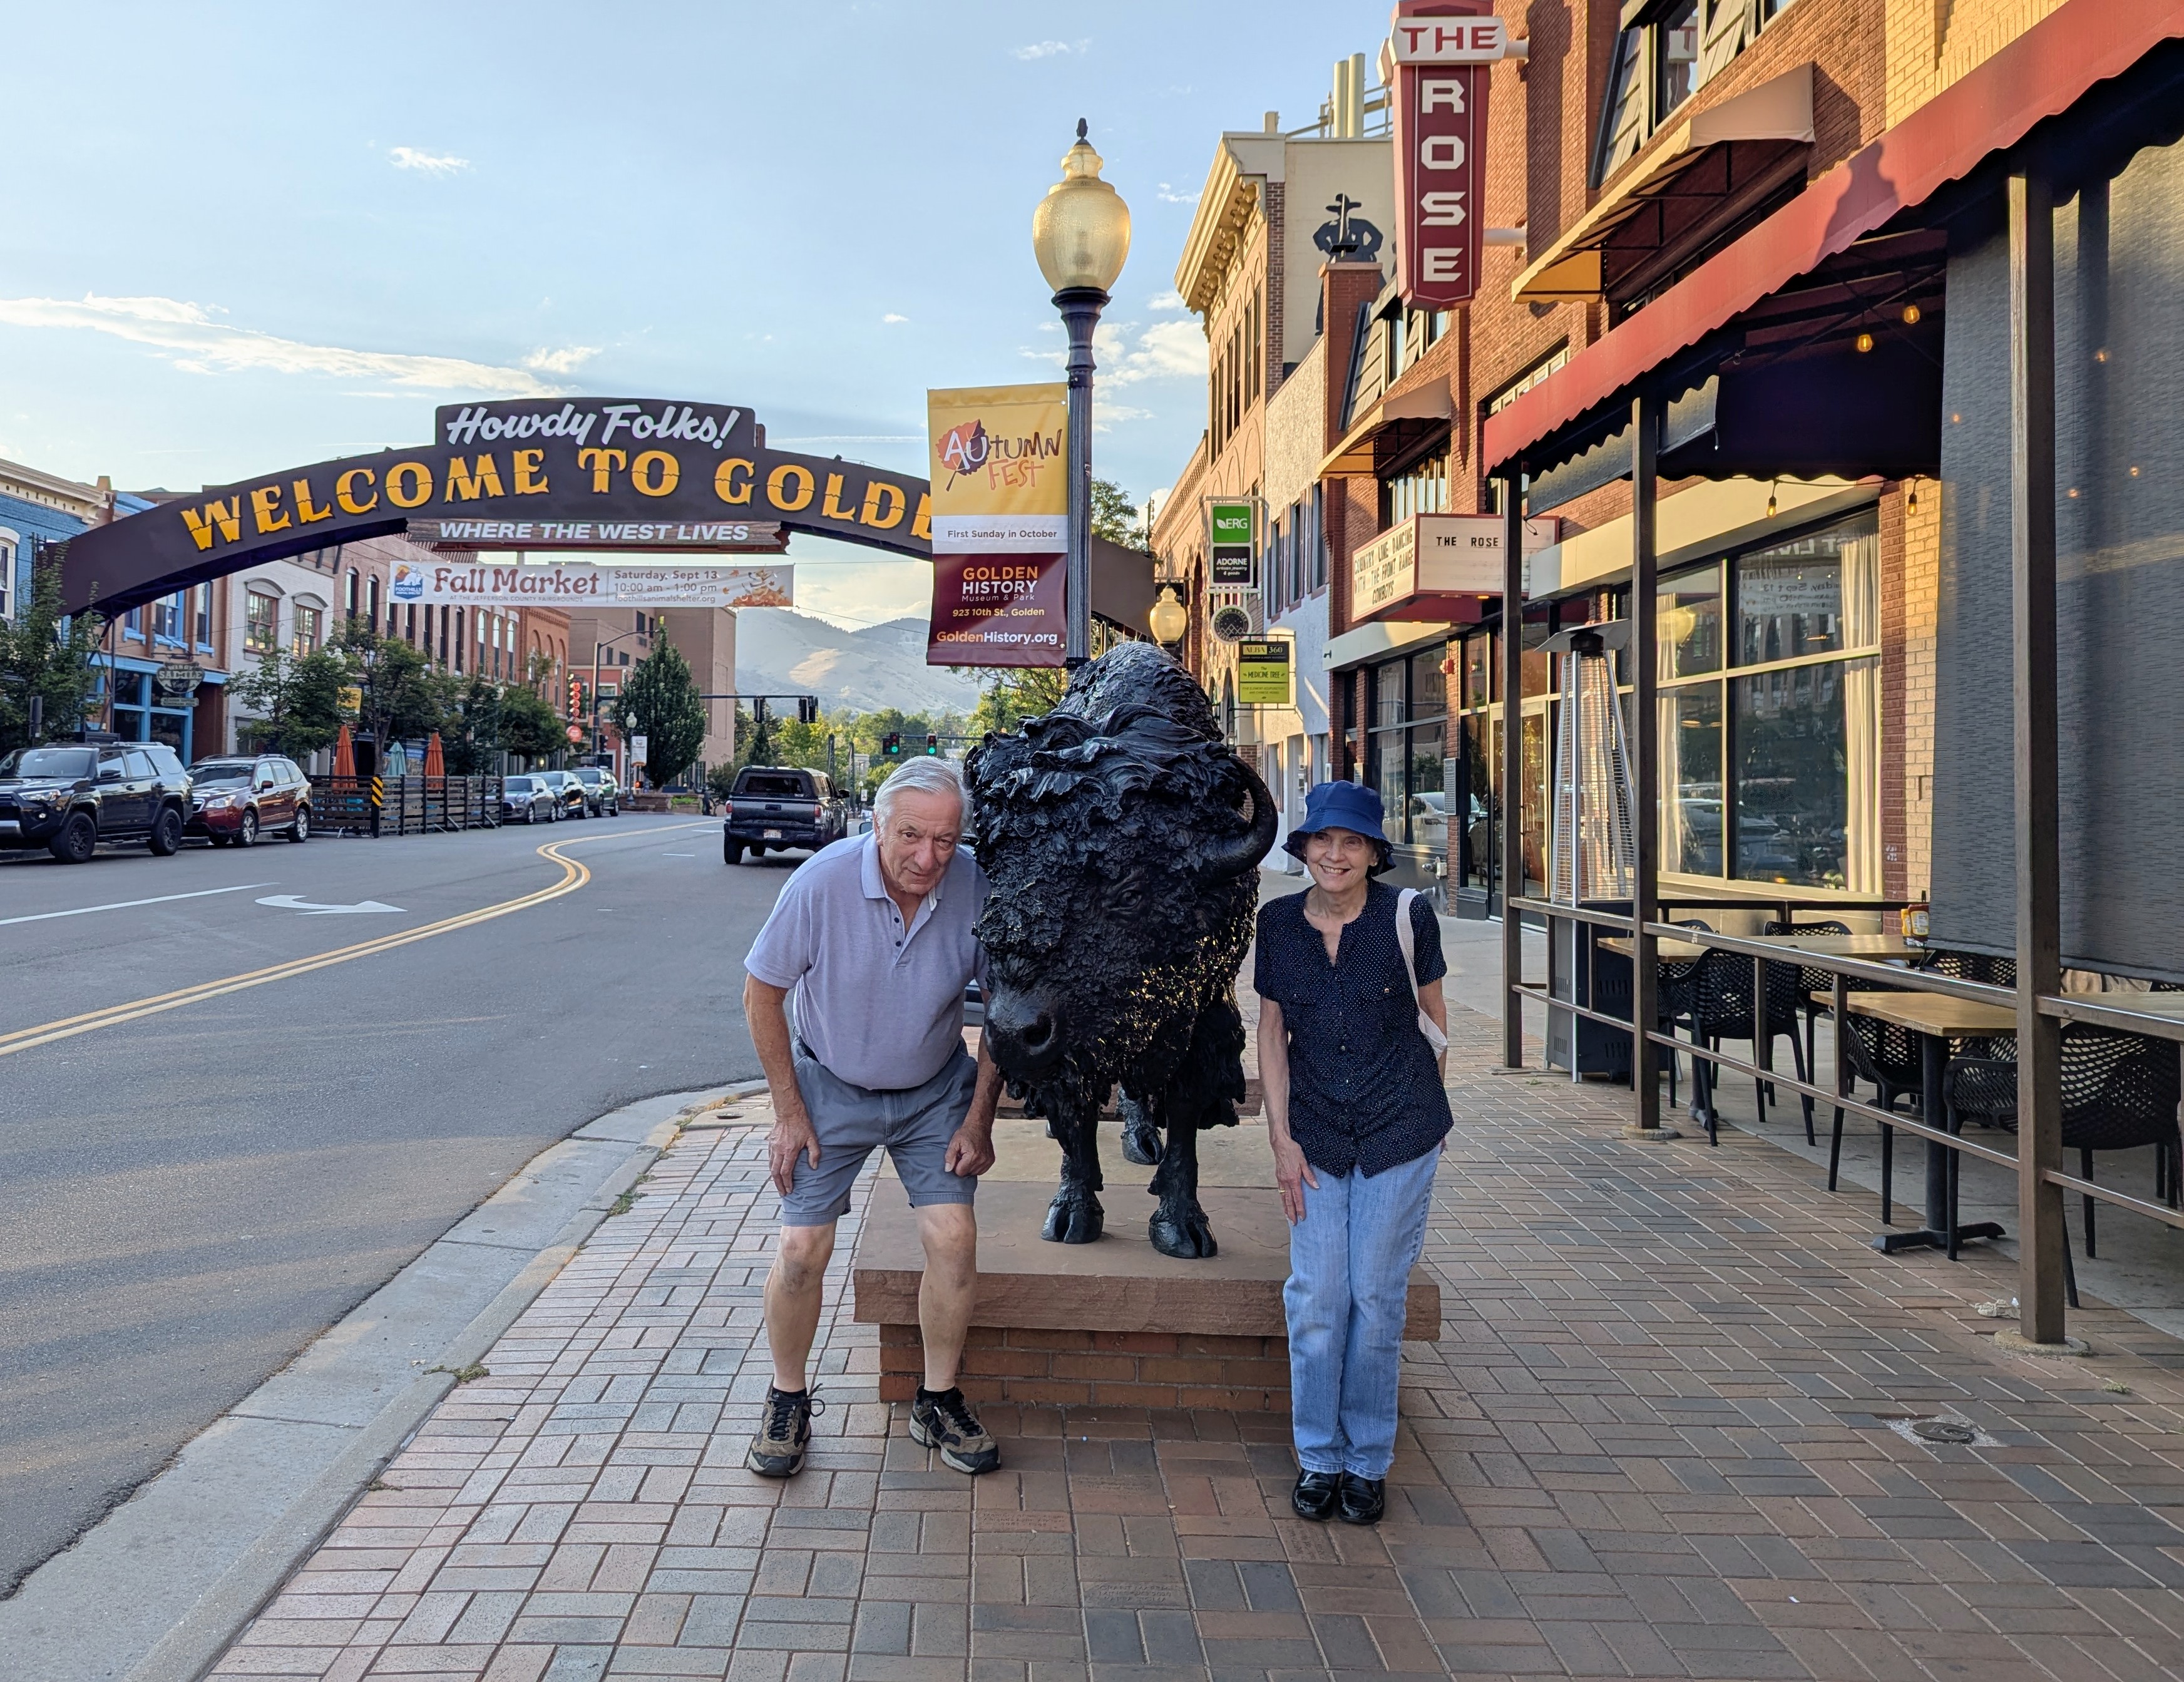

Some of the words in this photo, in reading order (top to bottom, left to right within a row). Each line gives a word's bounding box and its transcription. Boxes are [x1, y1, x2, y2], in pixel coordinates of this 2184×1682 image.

[1400, 26, 1499, 54] THE
[1420, 79, 1467, 281] ROSE
[446, 404, 598, 446] Howdy
[602, 405, 740, 449] Folks!
[988, 459, 1044, 491] FEST
[180, 449, 550, 551] WELCOME
[578, 448, 681, 496] TO
[714, 458, 932, 540] GOLD
[439, 523, 533, 539] WHERE
[540, 524, 592, 540] THE
[598, 525, 673, 540] WEST
[677, 525, 750, 541] LIVES
[1226, 518, 1248, 530] ERG
[972, 530, 1005, 539] Sunday
[1392, 526, 1413, 555] DANCING
[1436, 536, 1457, 546] THE
[1471, 537, 1499, 547] ROSE
[963, 566, 1038, 580] GOLDEN
[1371, 567, 1379, 586] THE
[1382, 558, 1397, 580] FRONT
[1399, 547, 1413, 572] RANGE
[433, 568, 486, 593] Fall
[492, 568, 600, 594] Market
[614, 570, 668, 581] Saturday,
[672, 570, 699, 581] Sept
[704, 570, 717, 579] 13
[615, 583, 643, 592] 10:00
[675, 583, 697, 592] 1:00
[700, 585, 717, 594] pm
[962, 580, 1038, 595] HISTORY
[1372, 580, 1394, 605] COWBOYS
[615, 595, 715, 603] foothillsanimalshelter.org
[952, 608, 970, 617] 923
[972, 608, 992, 616] 10th
[993, 608, 1009, 618] St.,
[1011, 608, 1045, 616] Golden
[936, 631, 1057, 645] GoldenHistory.org
